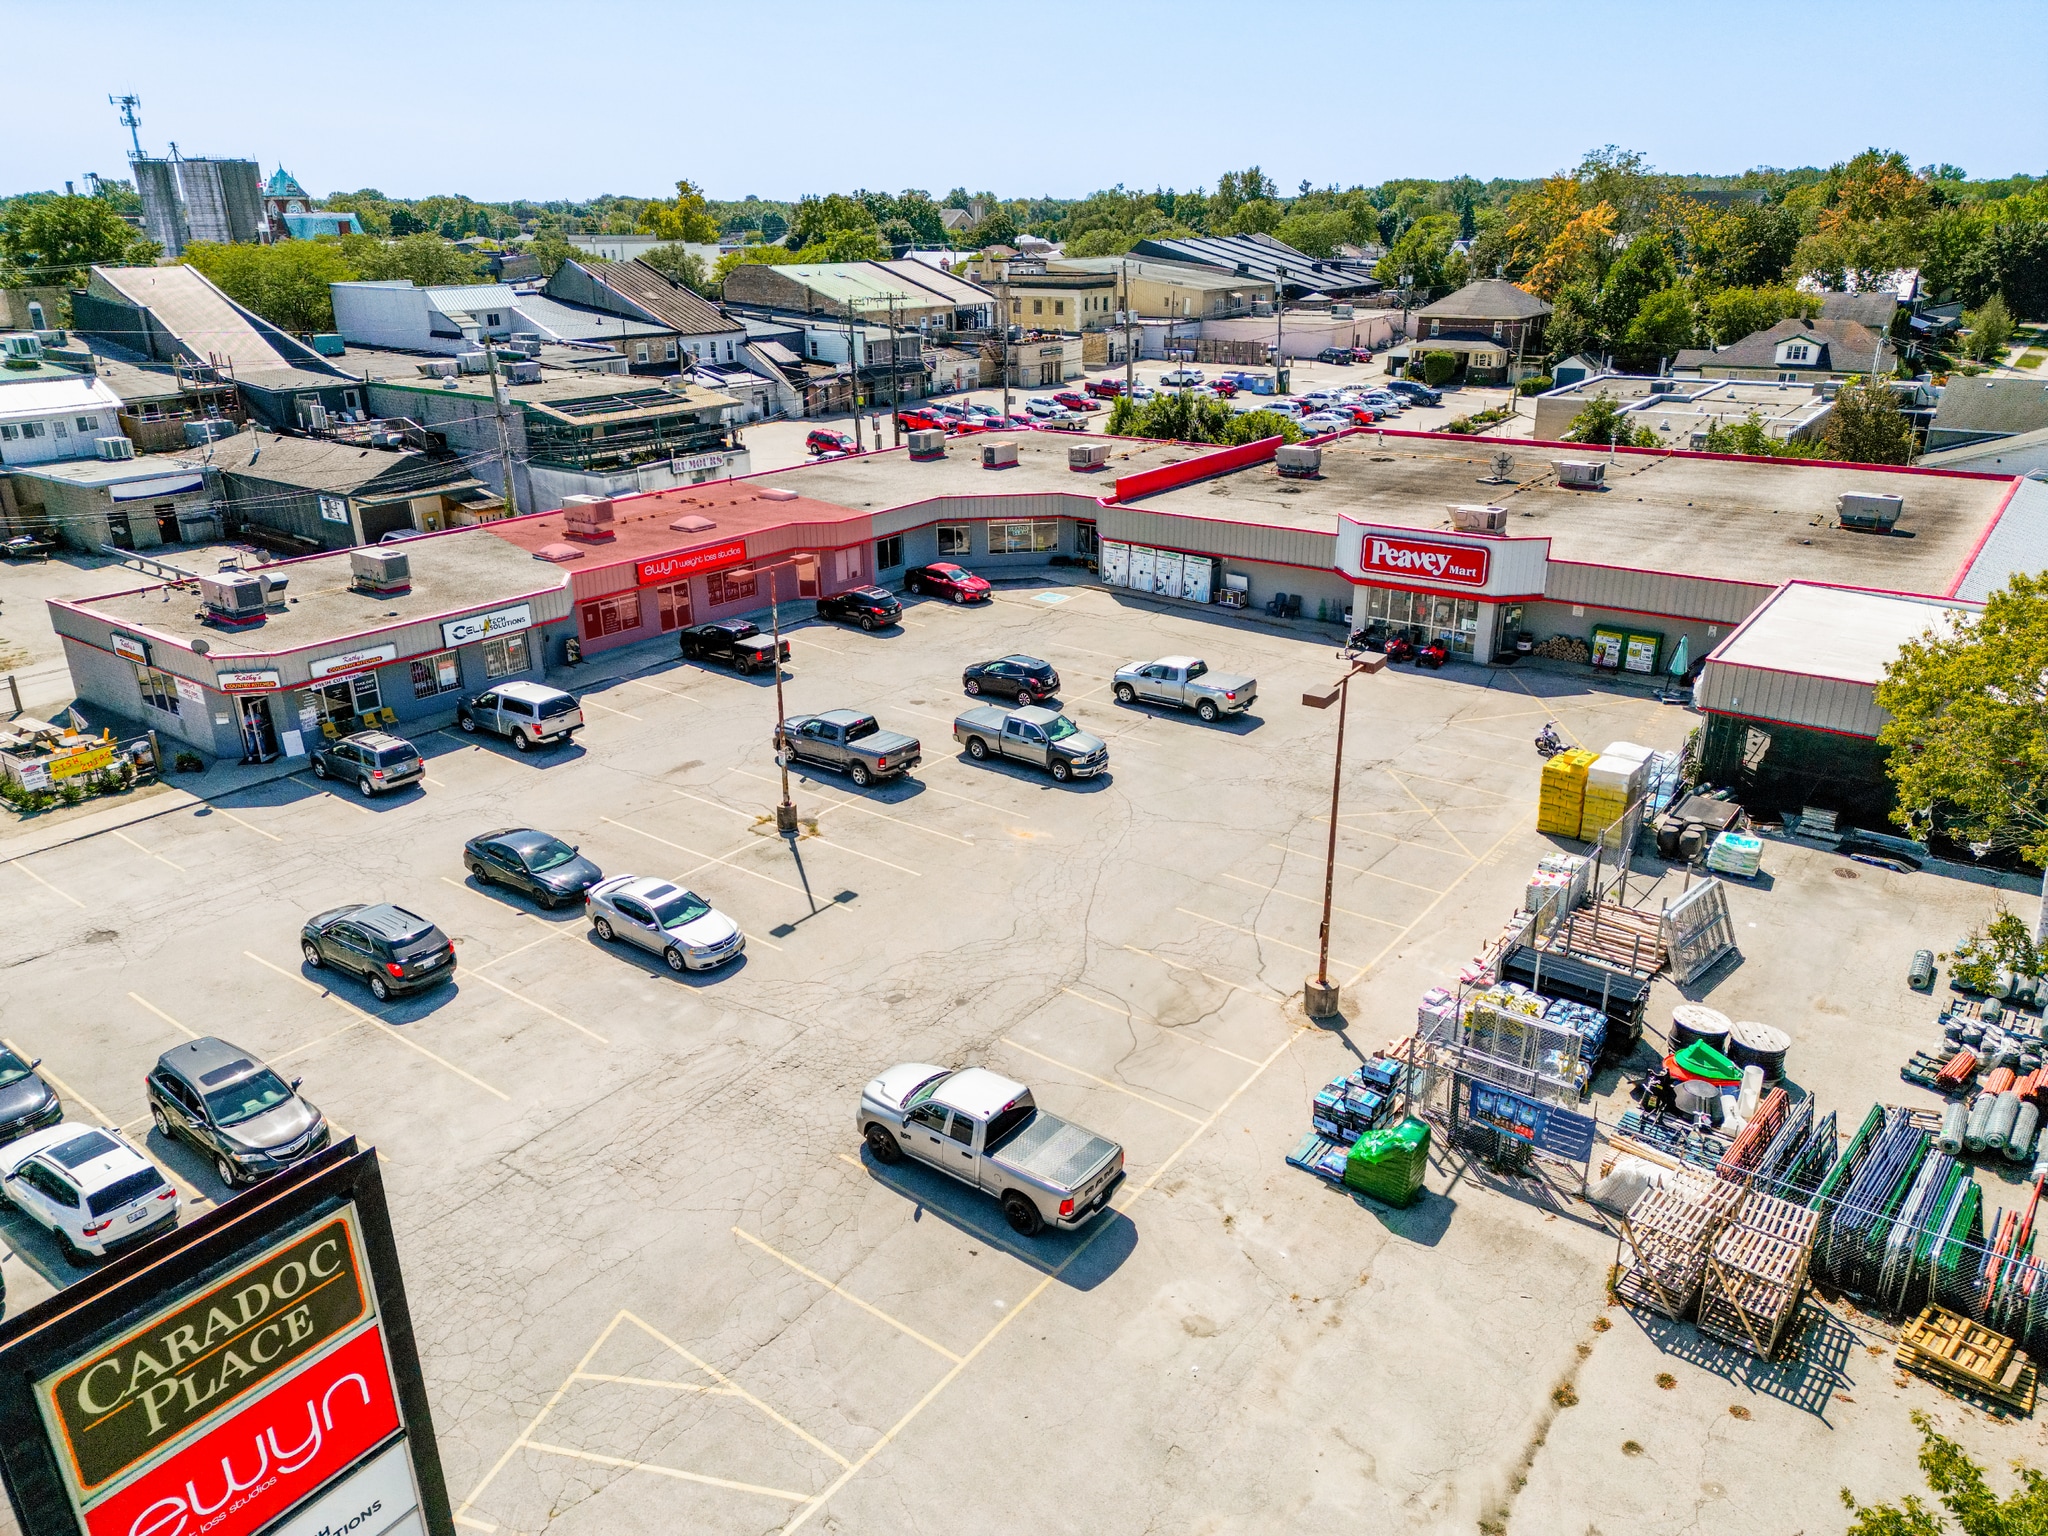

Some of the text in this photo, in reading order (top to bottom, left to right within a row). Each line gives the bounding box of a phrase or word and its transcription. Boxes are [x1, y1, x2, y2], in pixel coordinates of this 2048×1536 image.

[674, 456, 723, 471] RUMOURS
[644, 547, 741, 576] ewyn weight loss studios
[1370, 540, 1477, 577] Peavey Mart
[489, 616, 506, 625] TECH
[489, 617, 525, 631] SOLUTIONS
[343, 654, 364, 662] Kathy's
[53, 757, 79, 774] FISH
[81, 751, 110, 771] CHIPS
[1085, 1167, 1114, 1197] RAM
[77, 1239, 342, 1415] CARADOC
[135, 1305, 314, 1437] PLACE
[126, 1372, 370, 1536] ewyn
[200, 1476, 277, 1534] loss studios
